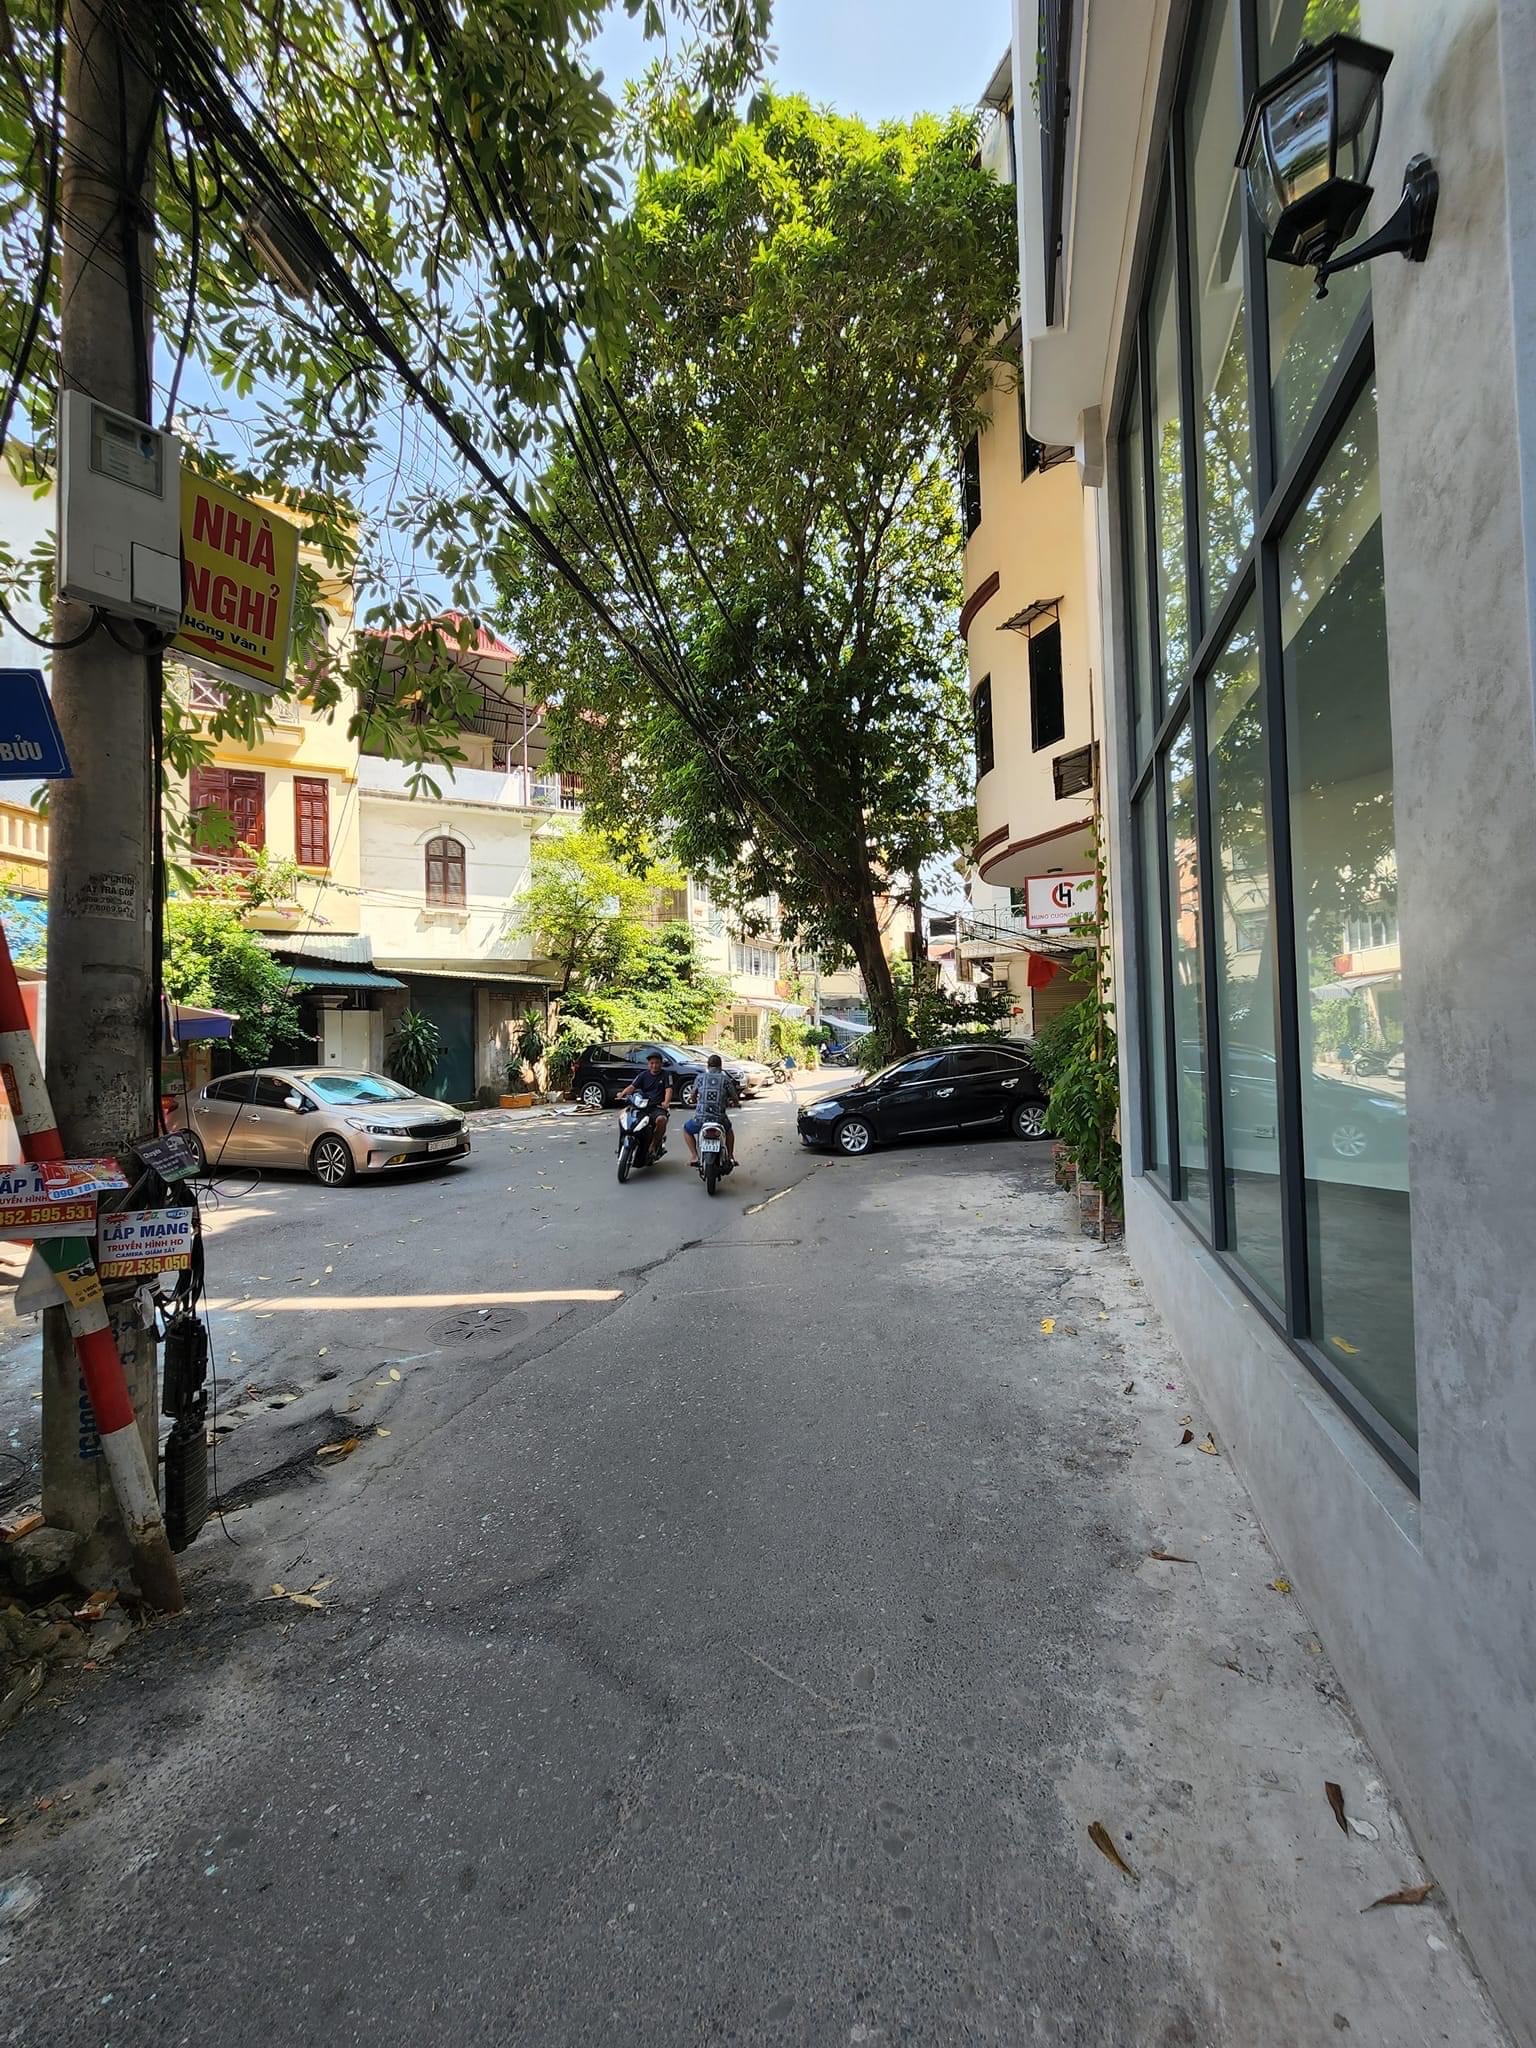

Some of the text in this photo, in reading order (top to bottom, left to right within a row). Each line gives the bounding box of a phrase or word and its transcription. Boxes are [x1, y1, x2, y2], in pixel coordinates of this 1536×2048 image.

[192, 494, 277, 577] NHÀ
[184, 560, 280, 641] NGHỈ
[229, 632, 257, 652] Vân
[0, 734, 43, 761] BỬU
[0, 1174, 27, 1194] ẮP
[103, 1222, 189, 1241] LẮP MẠNG
[145, 1240, 168, 1249] HÌNH
[170, 1238, 184, 1246] HD
[100, 1255, 189, 1278] 0972.535.050
